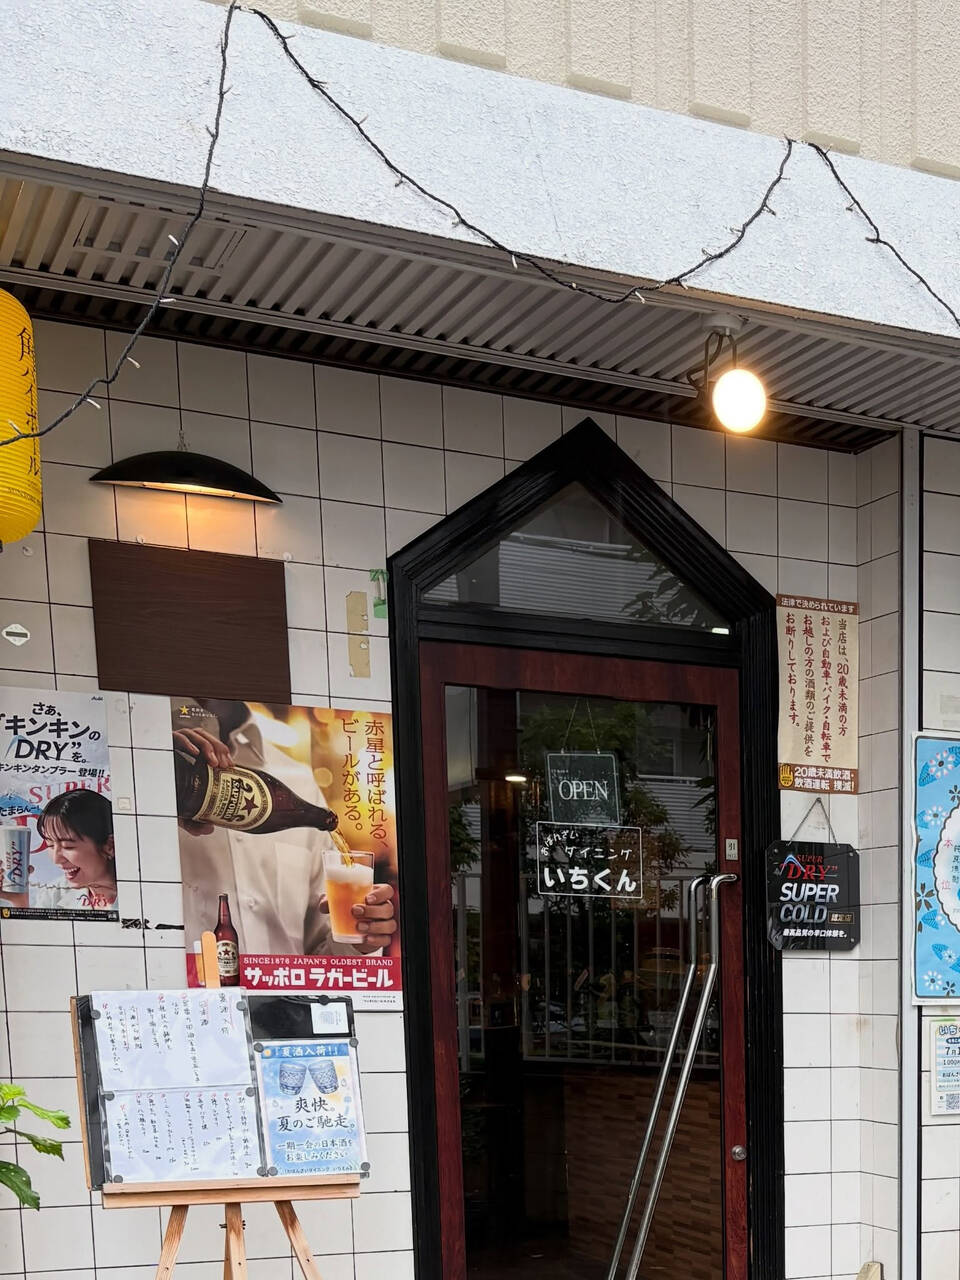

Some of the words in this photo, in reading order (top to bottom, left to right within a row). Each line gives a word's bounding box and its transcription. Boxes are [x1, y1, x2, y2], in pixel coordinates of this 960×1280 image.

[785, 612, 800, 727] お断りしております。
[837, 618, 849, 736] 当店は、20歳未満の方
[342, 718, 363, 831] ビールがある。
[365, 720, 388, 847] 赤星と呼ばれる、
[559, 780, 608, 800] OPEN
[544, 866, 637, 892] いちくん
[780, 882, 840, 903] SUPER
[780, 903, 827, 923] COLD
[331, 958, 362, 966] OLDEST
